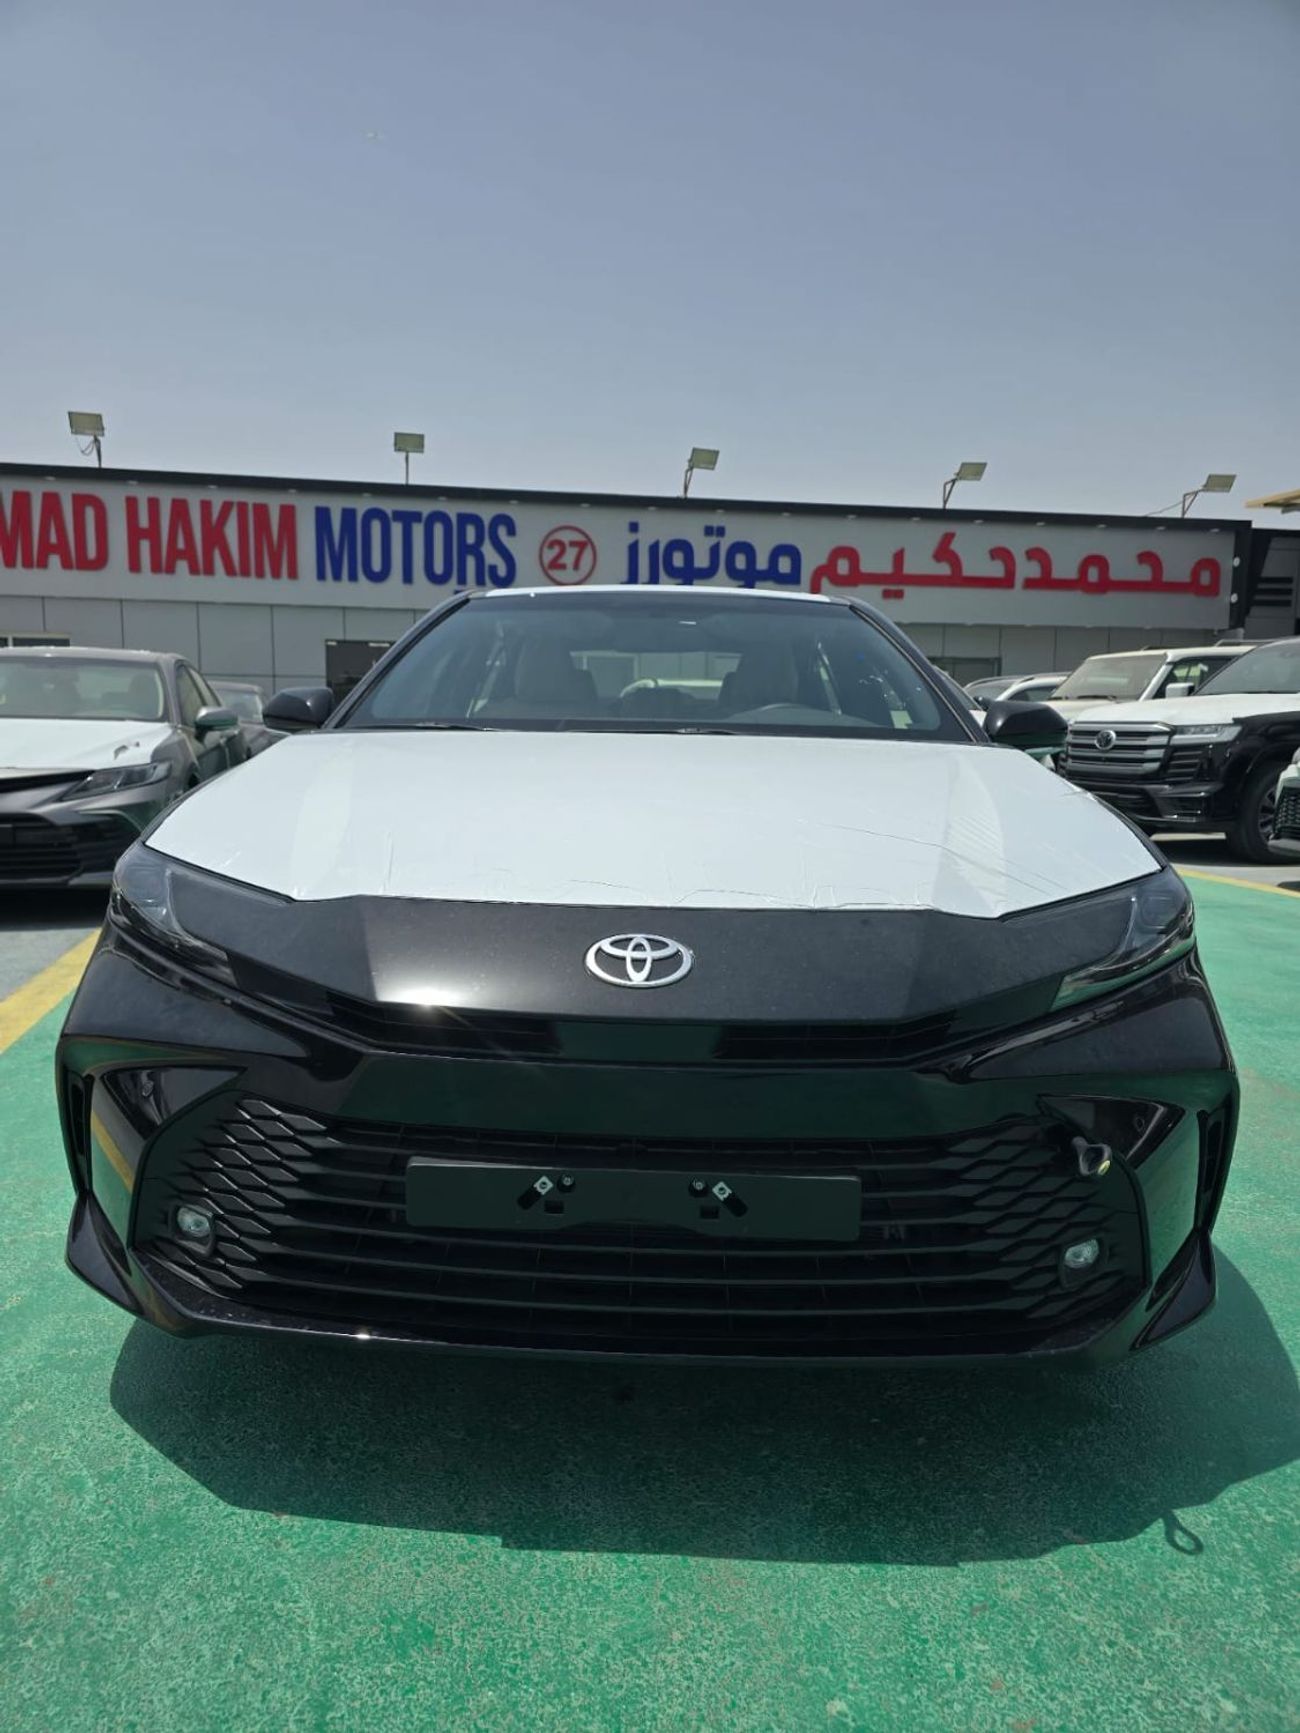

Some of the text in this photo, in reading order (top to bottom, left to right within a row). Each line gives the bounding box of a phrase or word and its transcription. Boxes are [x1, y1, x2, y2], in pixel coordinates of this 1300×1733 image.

[125, 495, 299, 580] HAKIM
[314, 506, 517, 588] MOTORS
[546, 539, 589, 571] 27
[621, 521, 802, 588] موتورز
